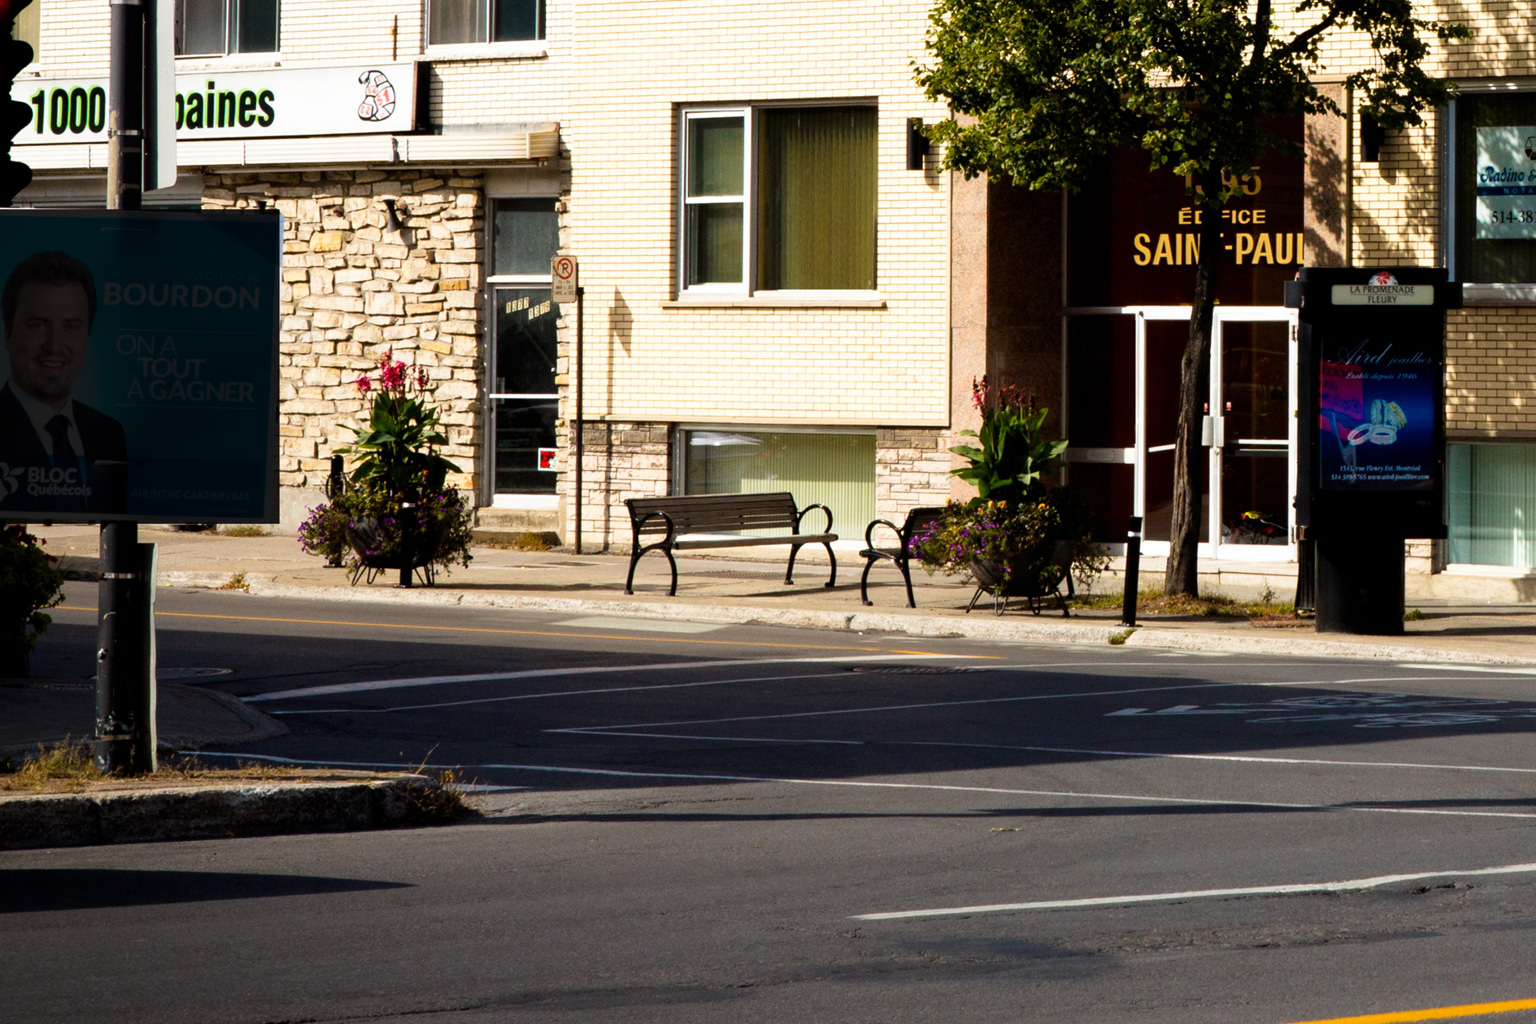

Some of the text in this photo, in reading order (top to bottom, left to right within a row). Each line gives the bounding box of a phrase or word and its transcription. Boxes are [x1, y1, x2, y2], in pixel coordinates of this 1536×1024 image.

[30, 85, 106, 135] 1000
[1480, 165, 1526, 183] Radino
[1134, 233, 1304, 266] SAIN-PAUL
[184, 271, 263, 282] AVEC NICOLAS
[103, 282, 260, 310] BOURDON
[1350, 286, 1415, 294] LA PROMENADE
[1367, 295, 1398, 304] FLEURY
[116, 334, 178, 355] ON A
[1327, 338, 1393, 365] Aird
[138, 357, 206, 379] TOUT
[1370, 372, 1395, 381] depuis
[126, 374, 255, 403] À GAGNER
[27, 466, 78, 484] BLOC
[27, 483, 92, 496] Québécois
[131, 488, 251, 501] AHUNTSIC-CARTIERVILLE
